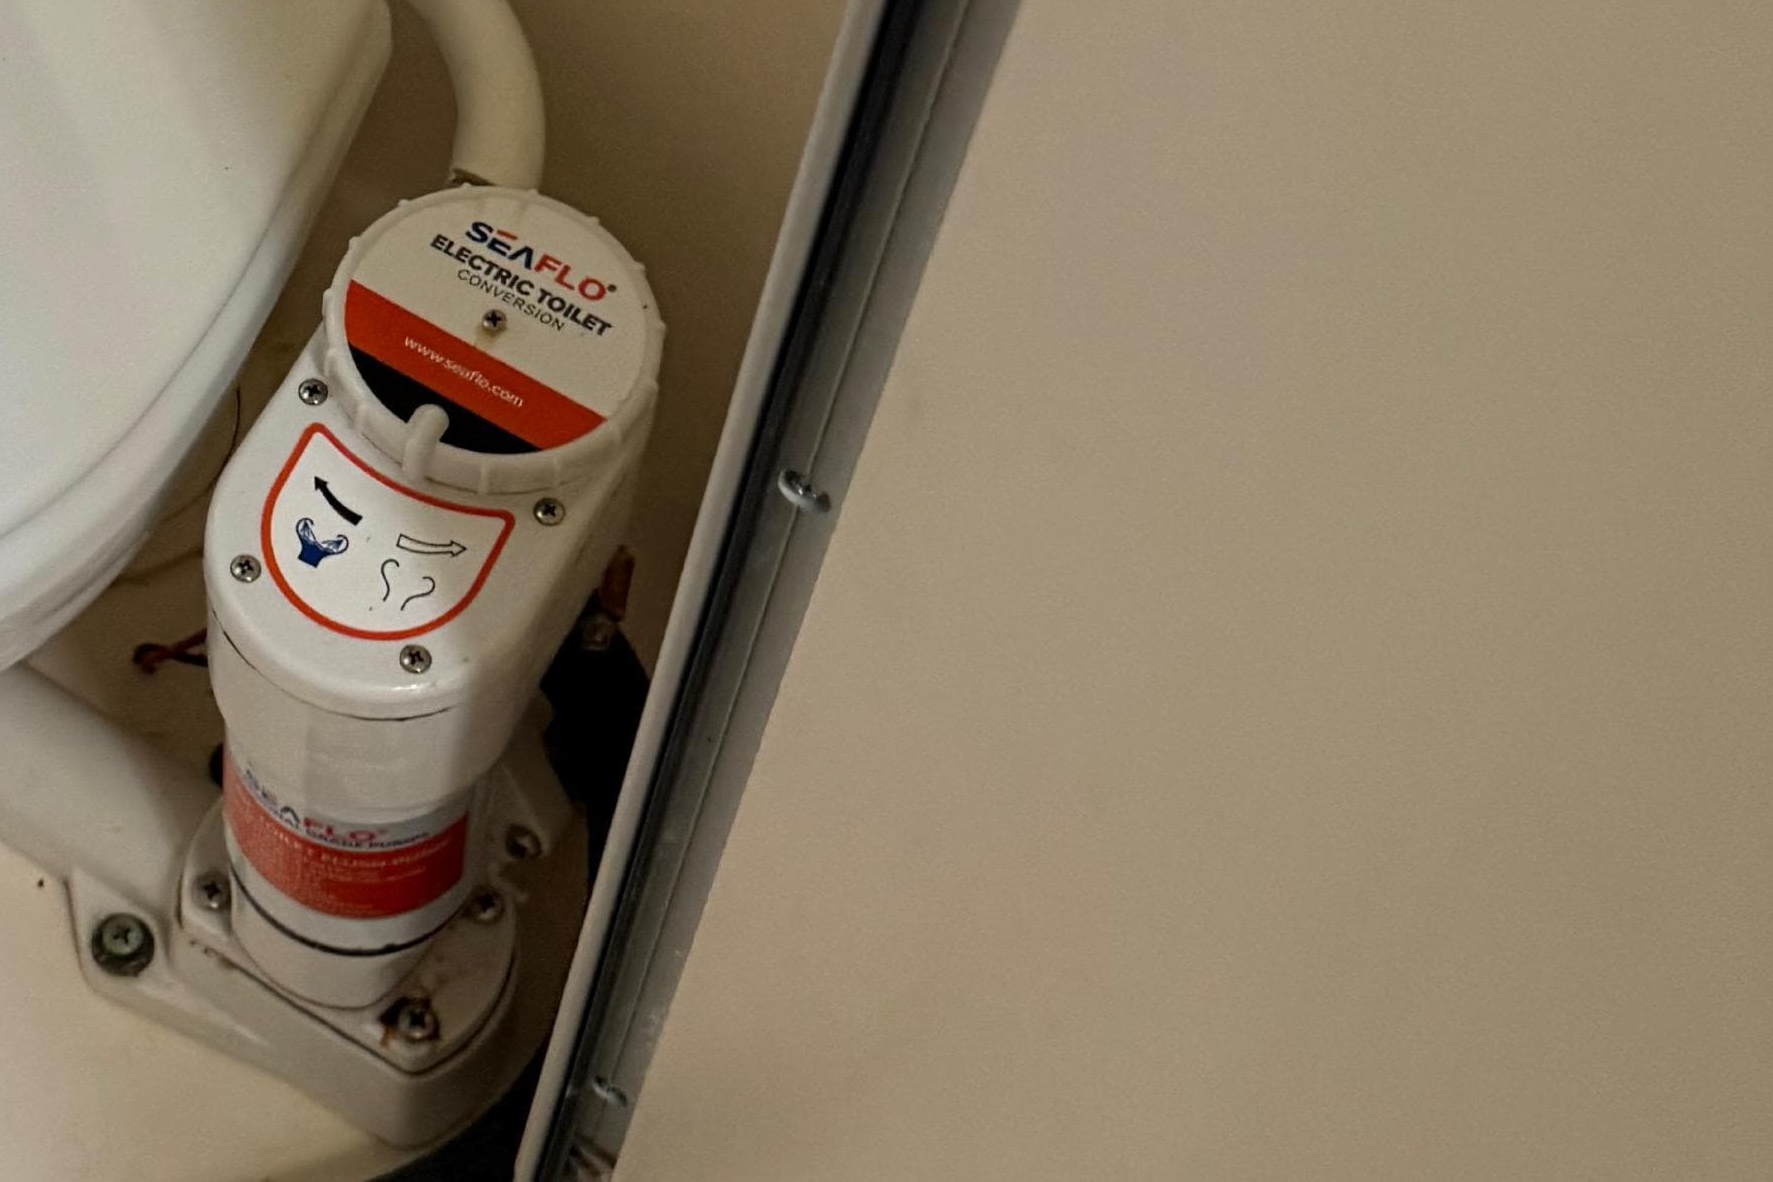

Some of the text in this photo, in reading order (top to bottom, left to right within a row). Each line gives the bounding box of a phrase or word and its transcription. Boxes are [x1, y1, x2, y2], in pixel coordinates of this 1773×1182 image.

[430, 234, 613, 336] ELECTRIC TOILET
[457, 269, 565, 332] CONVERSION
[404, 336, 524, 408] www.seaflo.com
